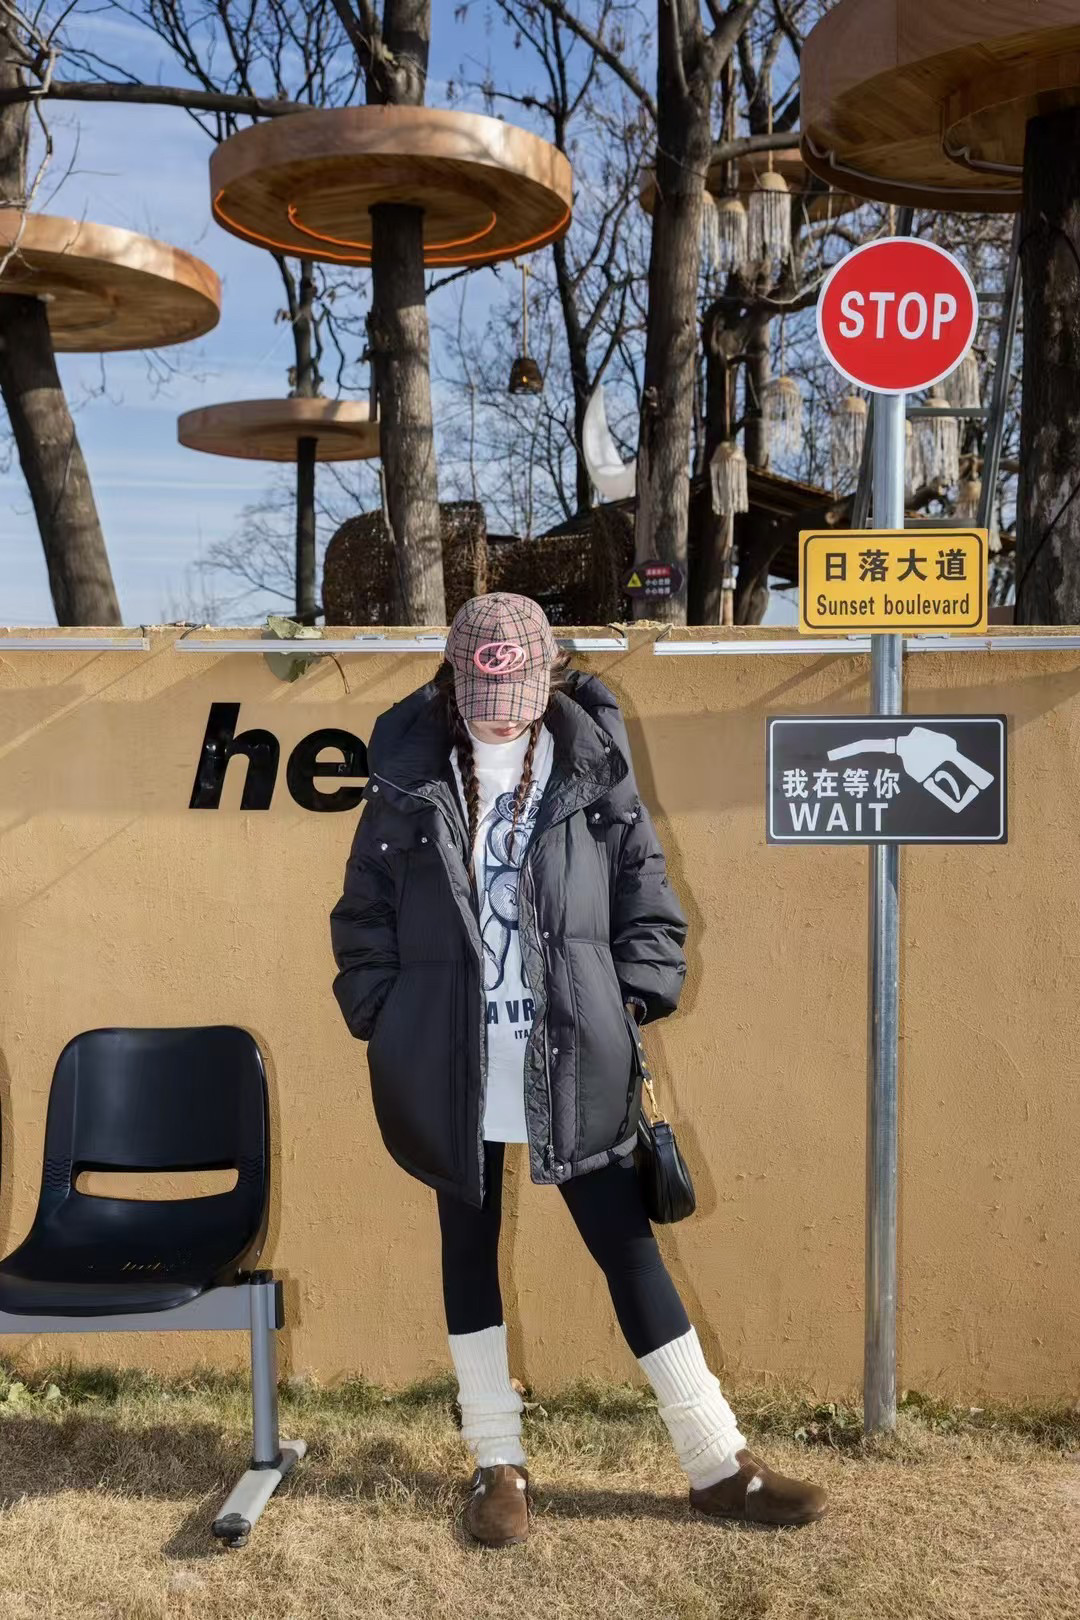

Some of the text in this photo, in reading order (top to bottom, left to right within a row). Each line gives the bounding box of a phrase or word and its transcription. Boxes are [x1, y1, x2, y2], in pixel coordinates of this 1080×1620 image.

[839, 291, 957, 340] STOP
[825, 548, 967, 582] 日落大道
[817, 593, 970, 616] Sunset boulevard
[782, 768, 900, 798] 我在等你
[789, 802, 889, 831] WAIT
